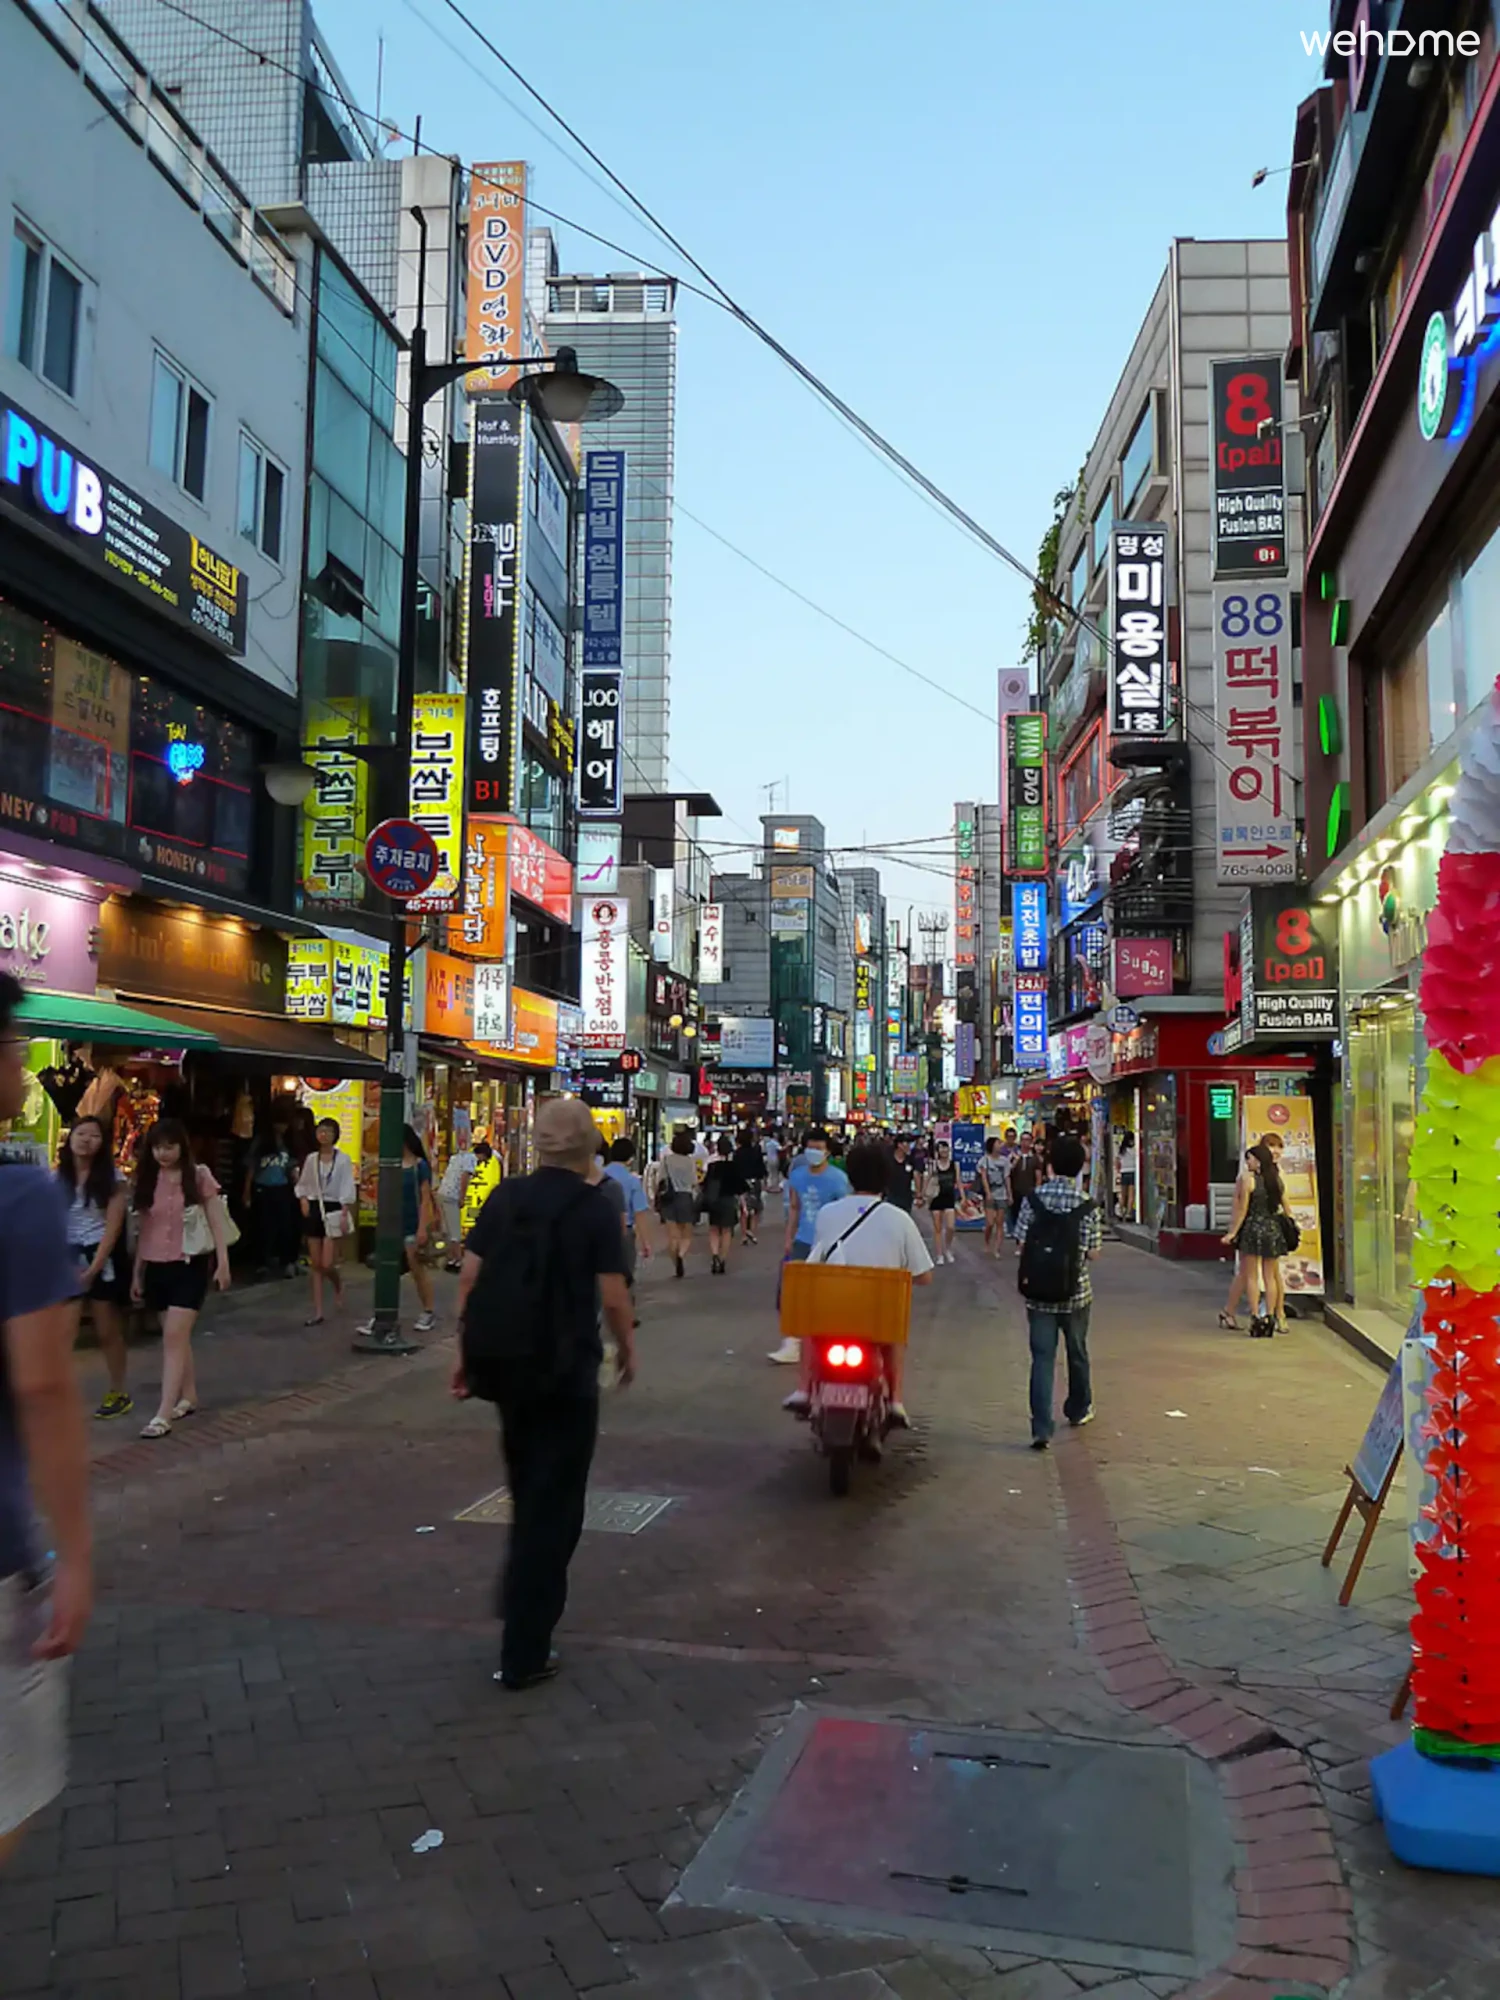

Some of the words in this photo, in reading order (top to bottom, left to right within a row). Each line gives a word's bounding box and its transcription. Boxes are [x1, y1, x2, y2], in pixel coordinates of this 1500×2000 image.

[1225, 373, 1272, 436] 8
[477, 420, 499, 431] Hof
[478, 433, 518, 445] Hunting
[7, 409, 103, 536] PUB
[1218, 496, 1243, 515] High
[1245, 494, 1282, 512] Quality
[1220, 519, 1255, 535] Fusion
[1257, 516, 1282, 532] BAR
[1117, 535, 1163, 556] 명성
[1221, 593, 1283, 637] 88
[1116, 561, 1164, 708] 미용실
[1118, 713, 1160, 731] 1층
[1020, 721, 1041, 758] WIN
[587, 719, 614, 790] 헤어
[475, 781, 499, 800] B1
[1023, 768, 1041, 804] DVD
[156, 845, 196, 873] HONEY
[376, 844, 431, 872] 주차금지
[1221, 863, 1293, 876] 765-4008
[1276, 908, 1312, 956] 8
[286, 964, 327, 987] 두부
[594, 929, 616, 1017] 홍콩반점
[1120, 949, 1165, 980] Sugar
[1265, 957, 1325, 982] [pal]
[1257, 997, 1285, 1011] High
[1288, 997, 1333, 1011] Quality
[1019, 995, 1042, 1052] 편의점
[1259, 1013, 1301, 1027] Fusion
[1303, 1012, 1333, 1026] BAR
[621, 1054, 639, 1069] B1
